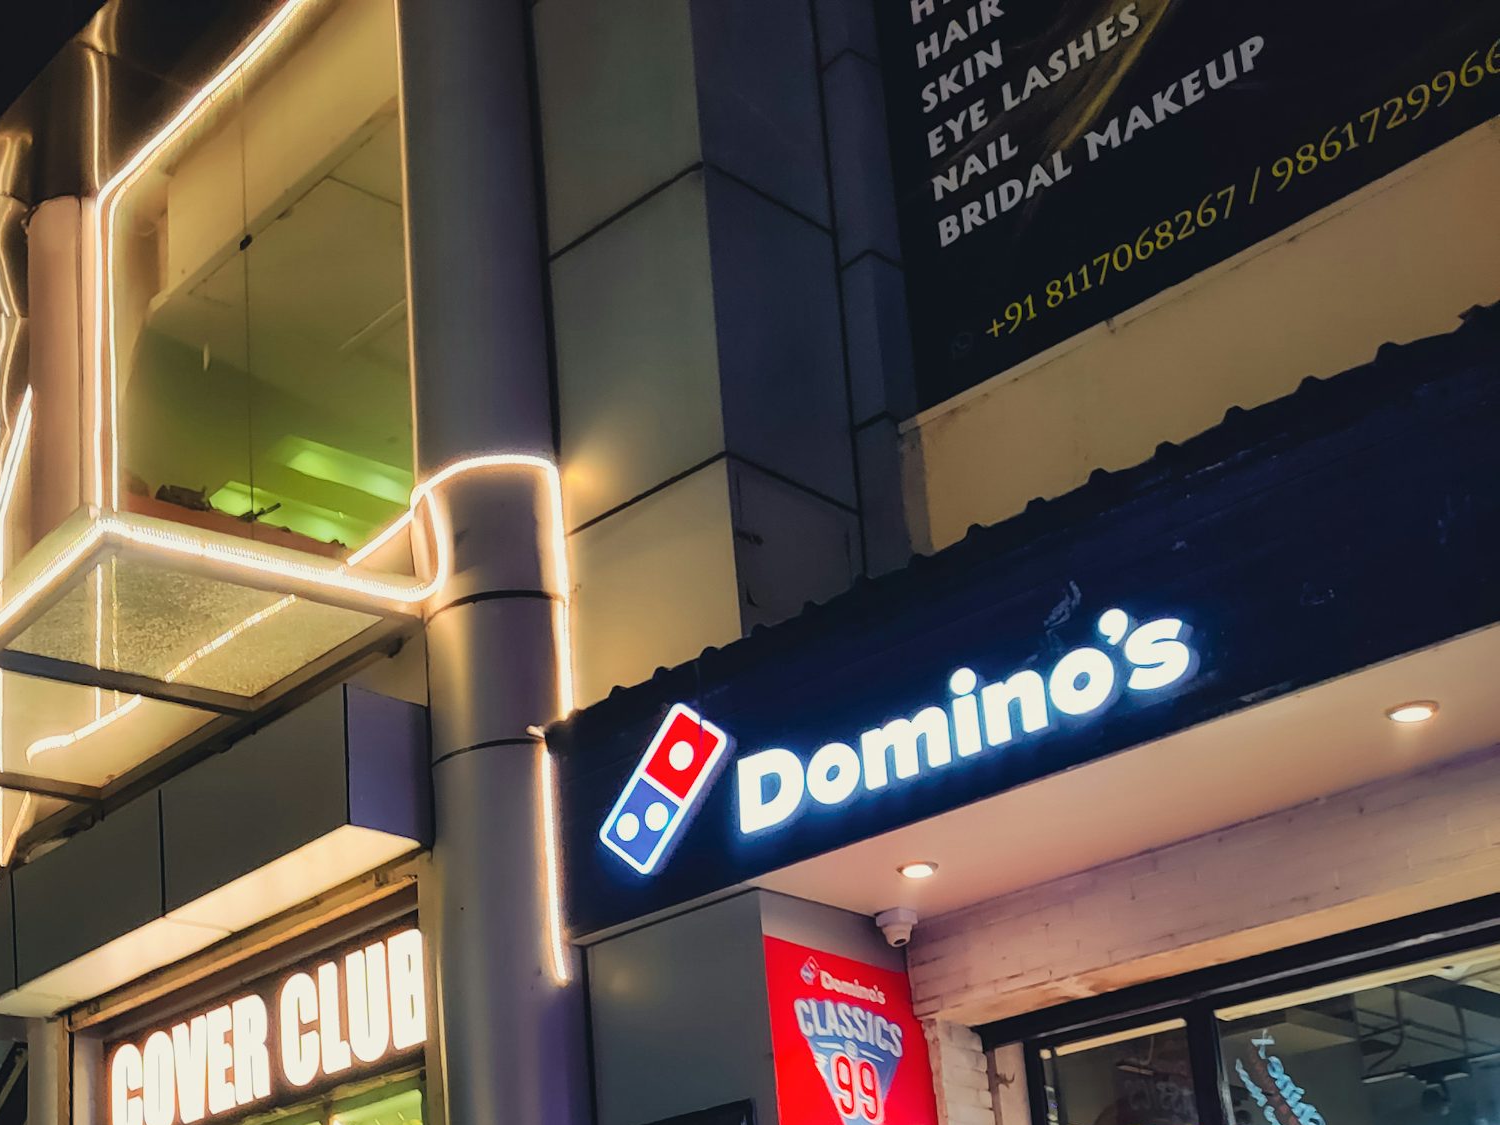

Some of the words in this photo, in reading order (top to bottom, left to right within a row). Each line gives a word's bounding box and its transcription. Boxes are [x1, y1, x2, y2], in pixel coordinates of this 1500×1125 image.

[915, 0, 1007, 69] HAIR
[921, 38, 1003, 114] SKIN
[927, 106, 989, 158] EYE
[1002, 3, 1140, 112] LASHES
[931, 134, 1019, 201] NAIL
[938, 158, 1072, 248] BRIDAL
[1085, 35, 1265, 162] MAKEUP
[986, 293, 1037, 340] +91
[1046, 184, 1237, 309] 8117068267
[736, 607, 1192, 834] Domino's
[280, 928, 428, 1087] CLUB
[820, 969, 886, 1005] Domino's
[793, 997, 903, 1058] CLASSICS
[832, 1052, 884, 1125] 99
